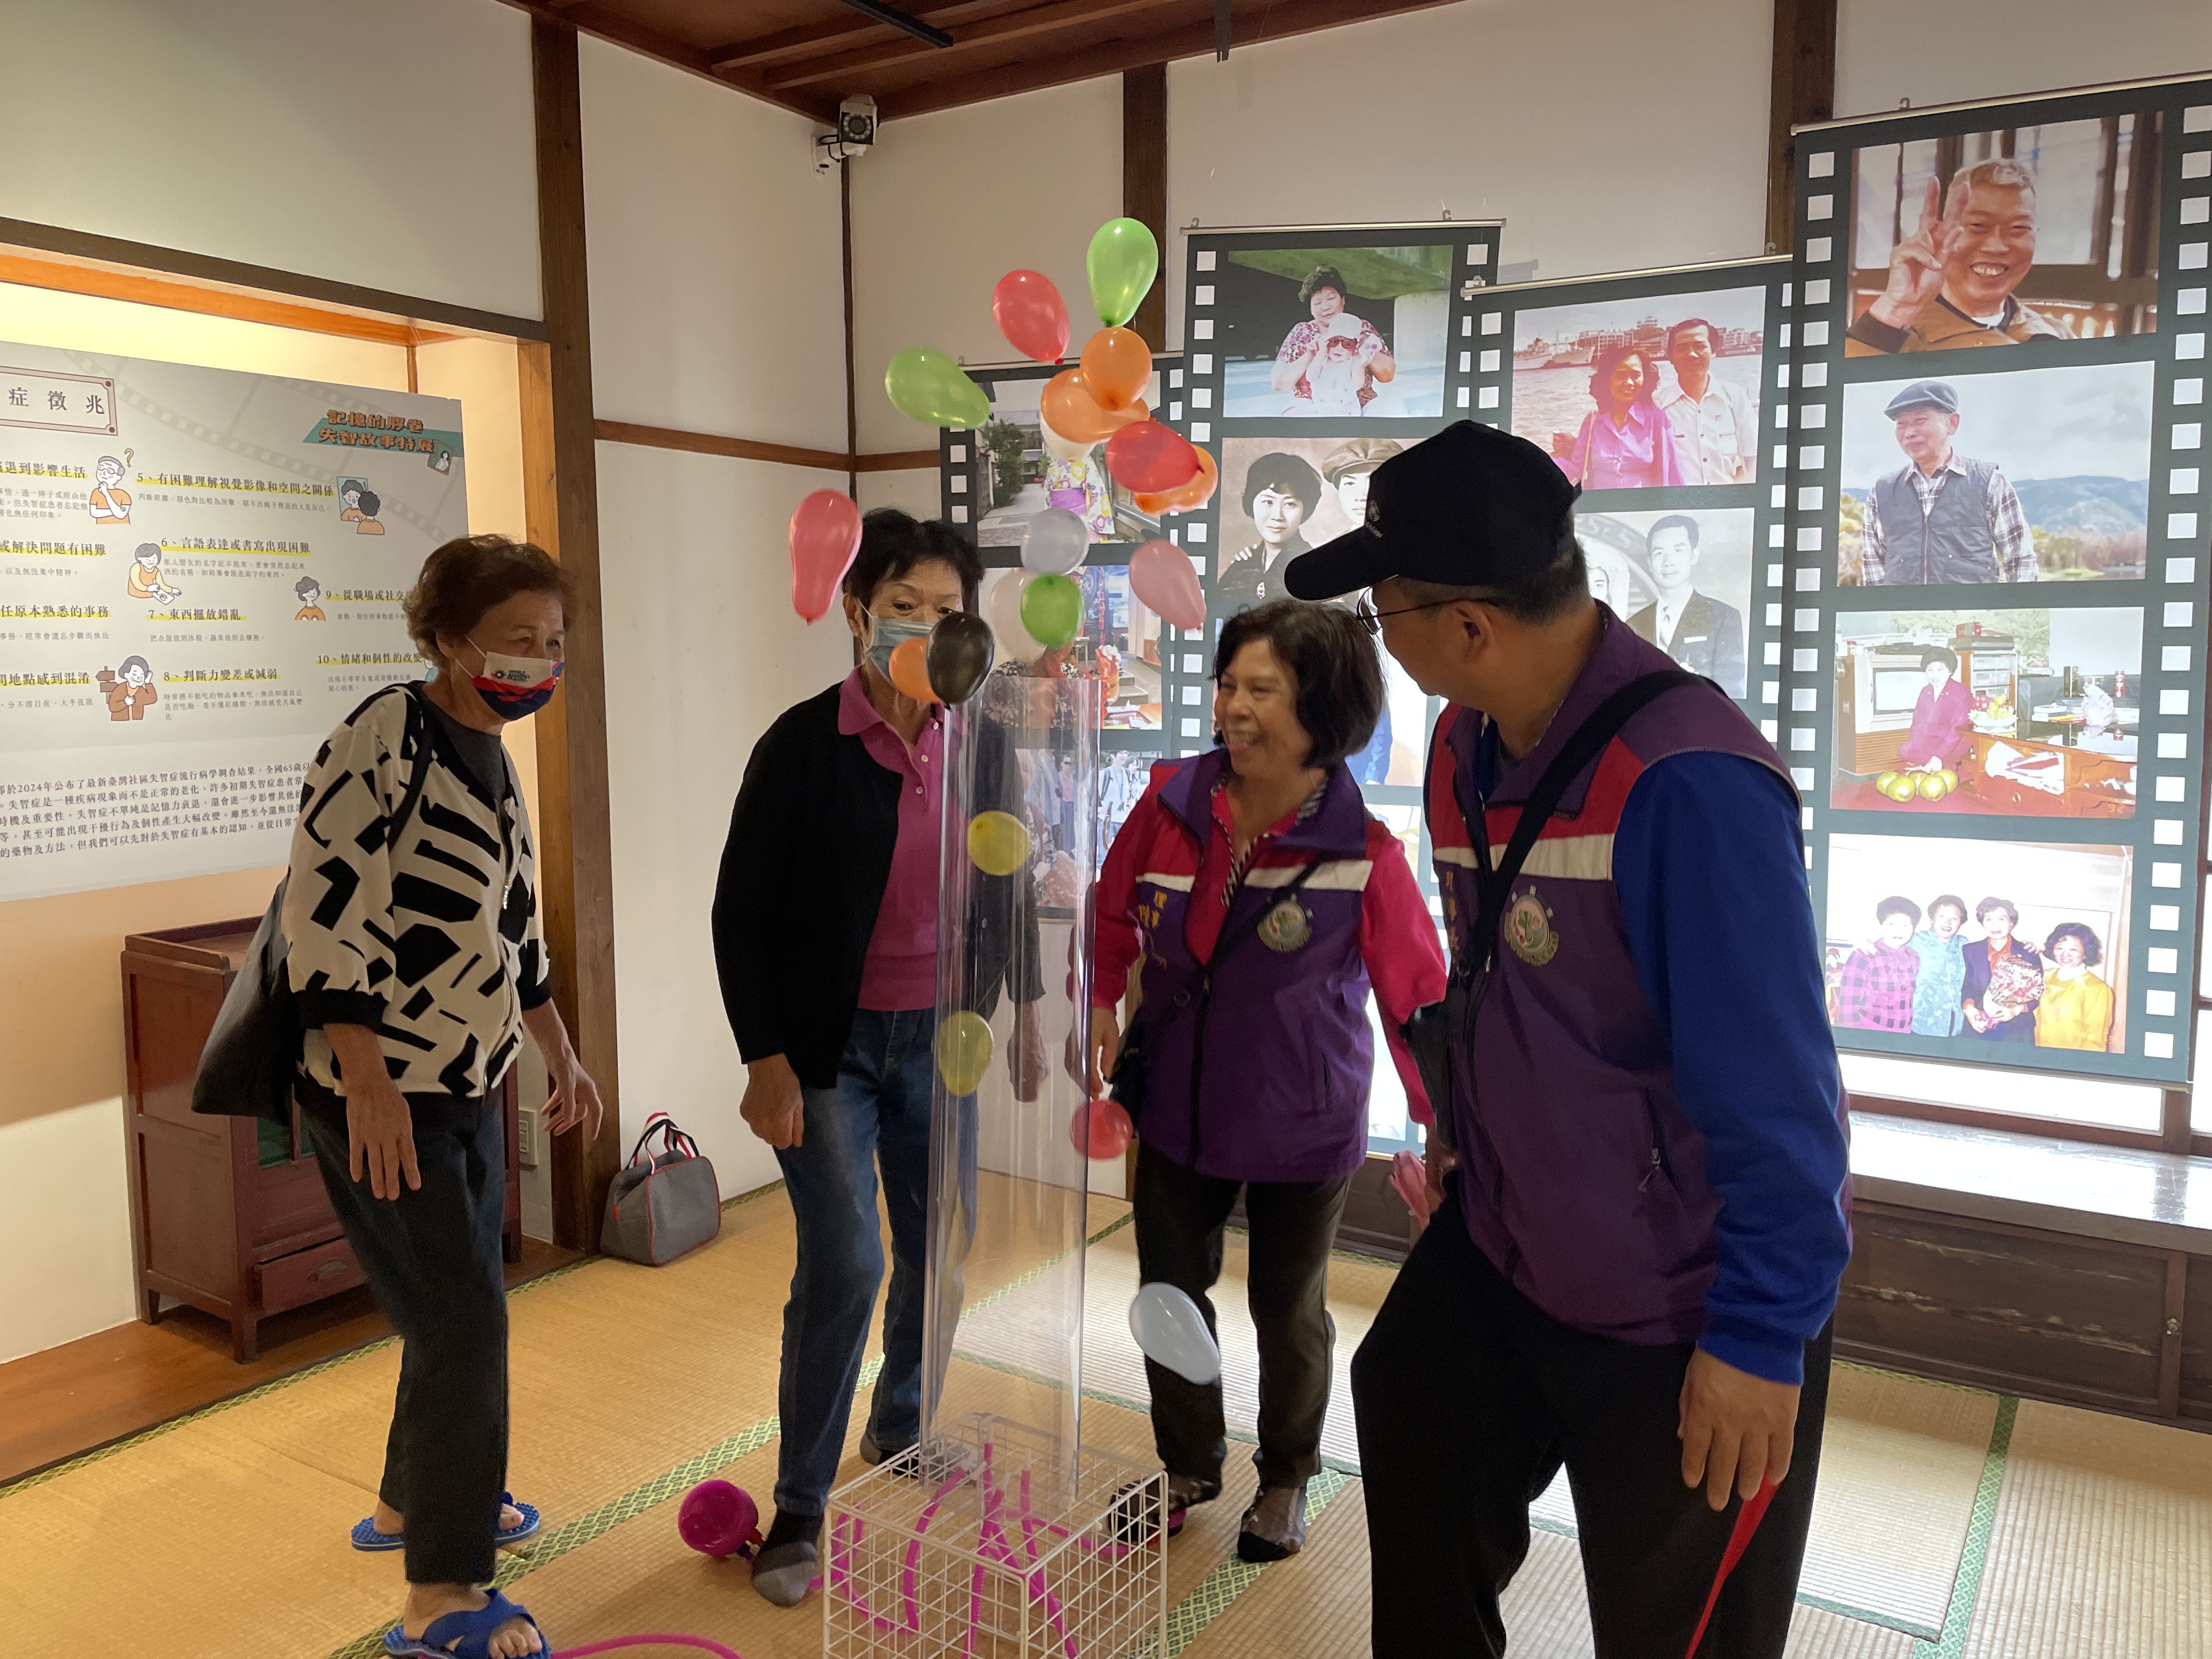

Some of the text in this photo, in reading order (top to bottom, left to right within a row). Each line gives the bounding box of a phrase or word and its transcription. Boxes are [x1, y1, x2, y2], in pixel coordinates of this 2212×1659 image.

[326, 409, 424, 434] 記憶的膠卷
[318, 427, 435, 454] 失智故事特展
[0, 460, 86, 479] 退到影響生活
